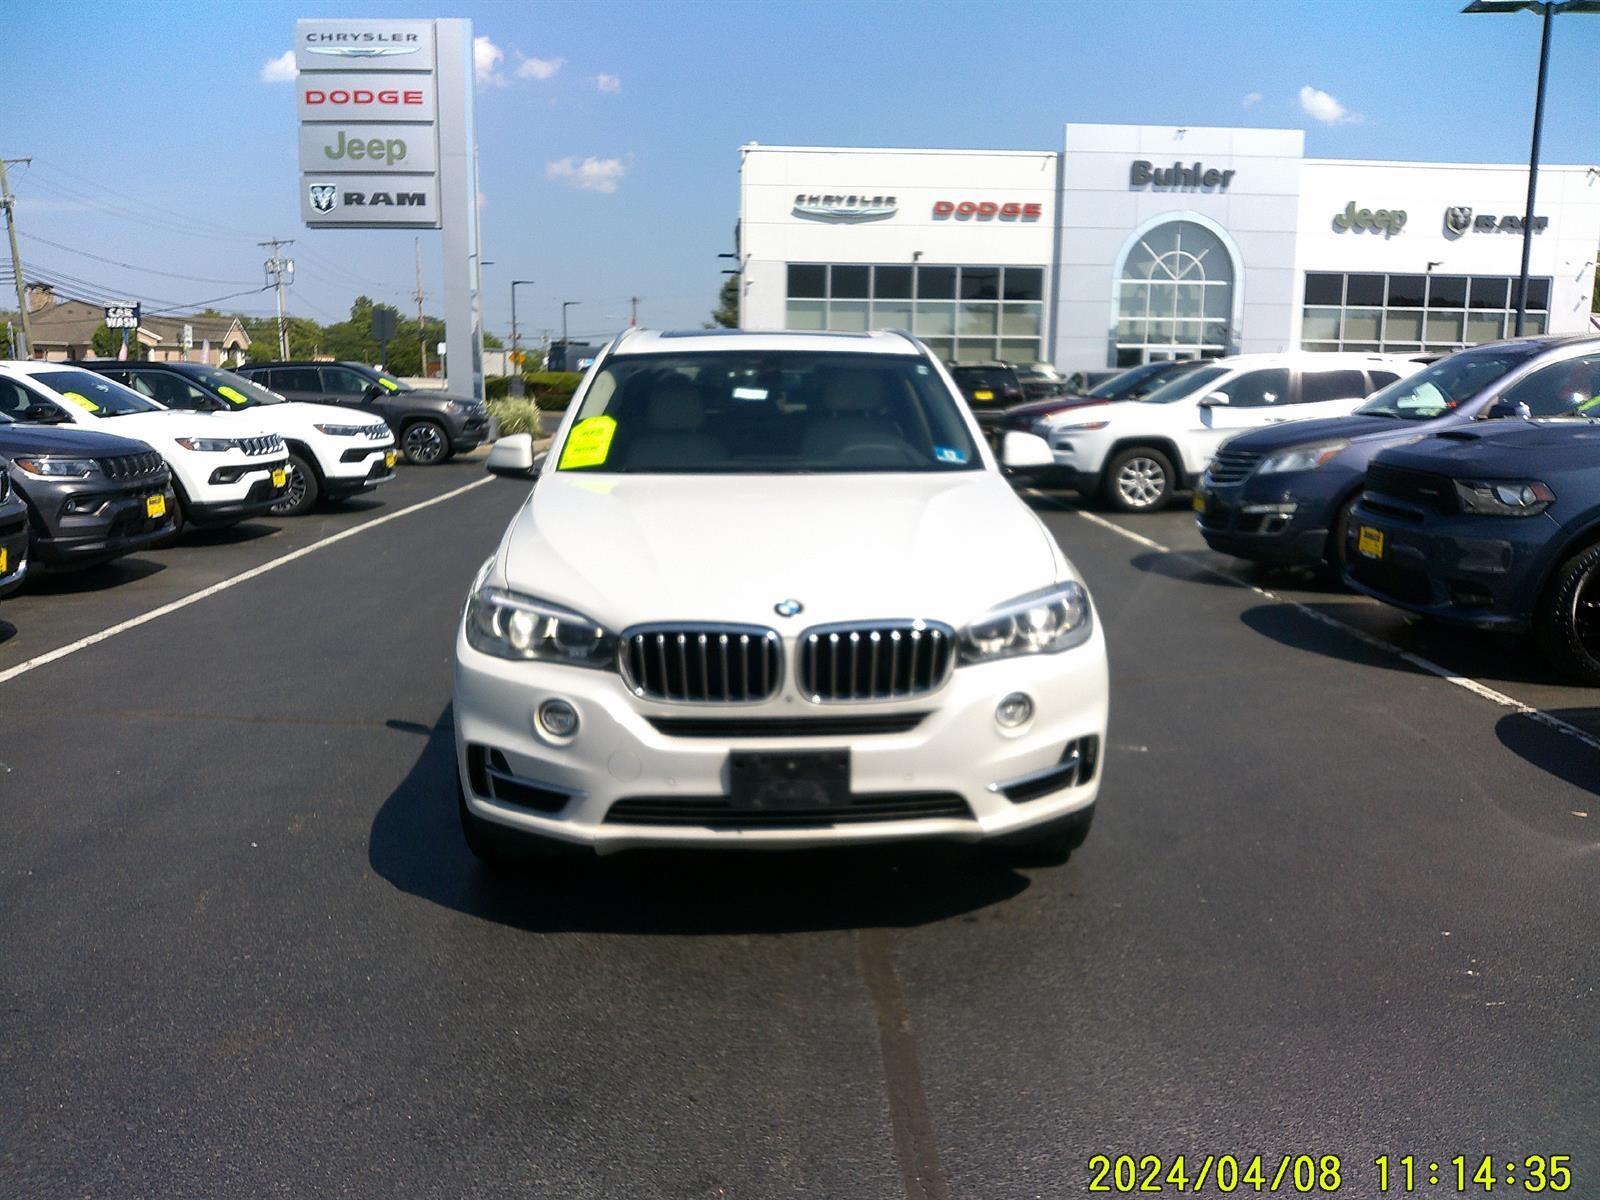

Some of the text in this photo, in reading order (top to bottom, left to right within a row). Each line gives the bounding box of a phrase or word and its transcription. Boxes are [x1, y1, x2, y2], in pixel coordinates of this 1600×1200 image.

[306, 32, 419, 42] CHRYSLER
[305, 90, 424, 105] DODGE
[324, 131, 408, 166] Jeep
[1130, 160, 1235, 188] Buhler
[343, 192, 426, 206] RAM
[794, 193, 897, 207] CHRYSLER
[933, 200, 1043, 220] DODGE
[1333, 200, 1407, 239] Jeep
[106, 317, 138, 328] WASH
